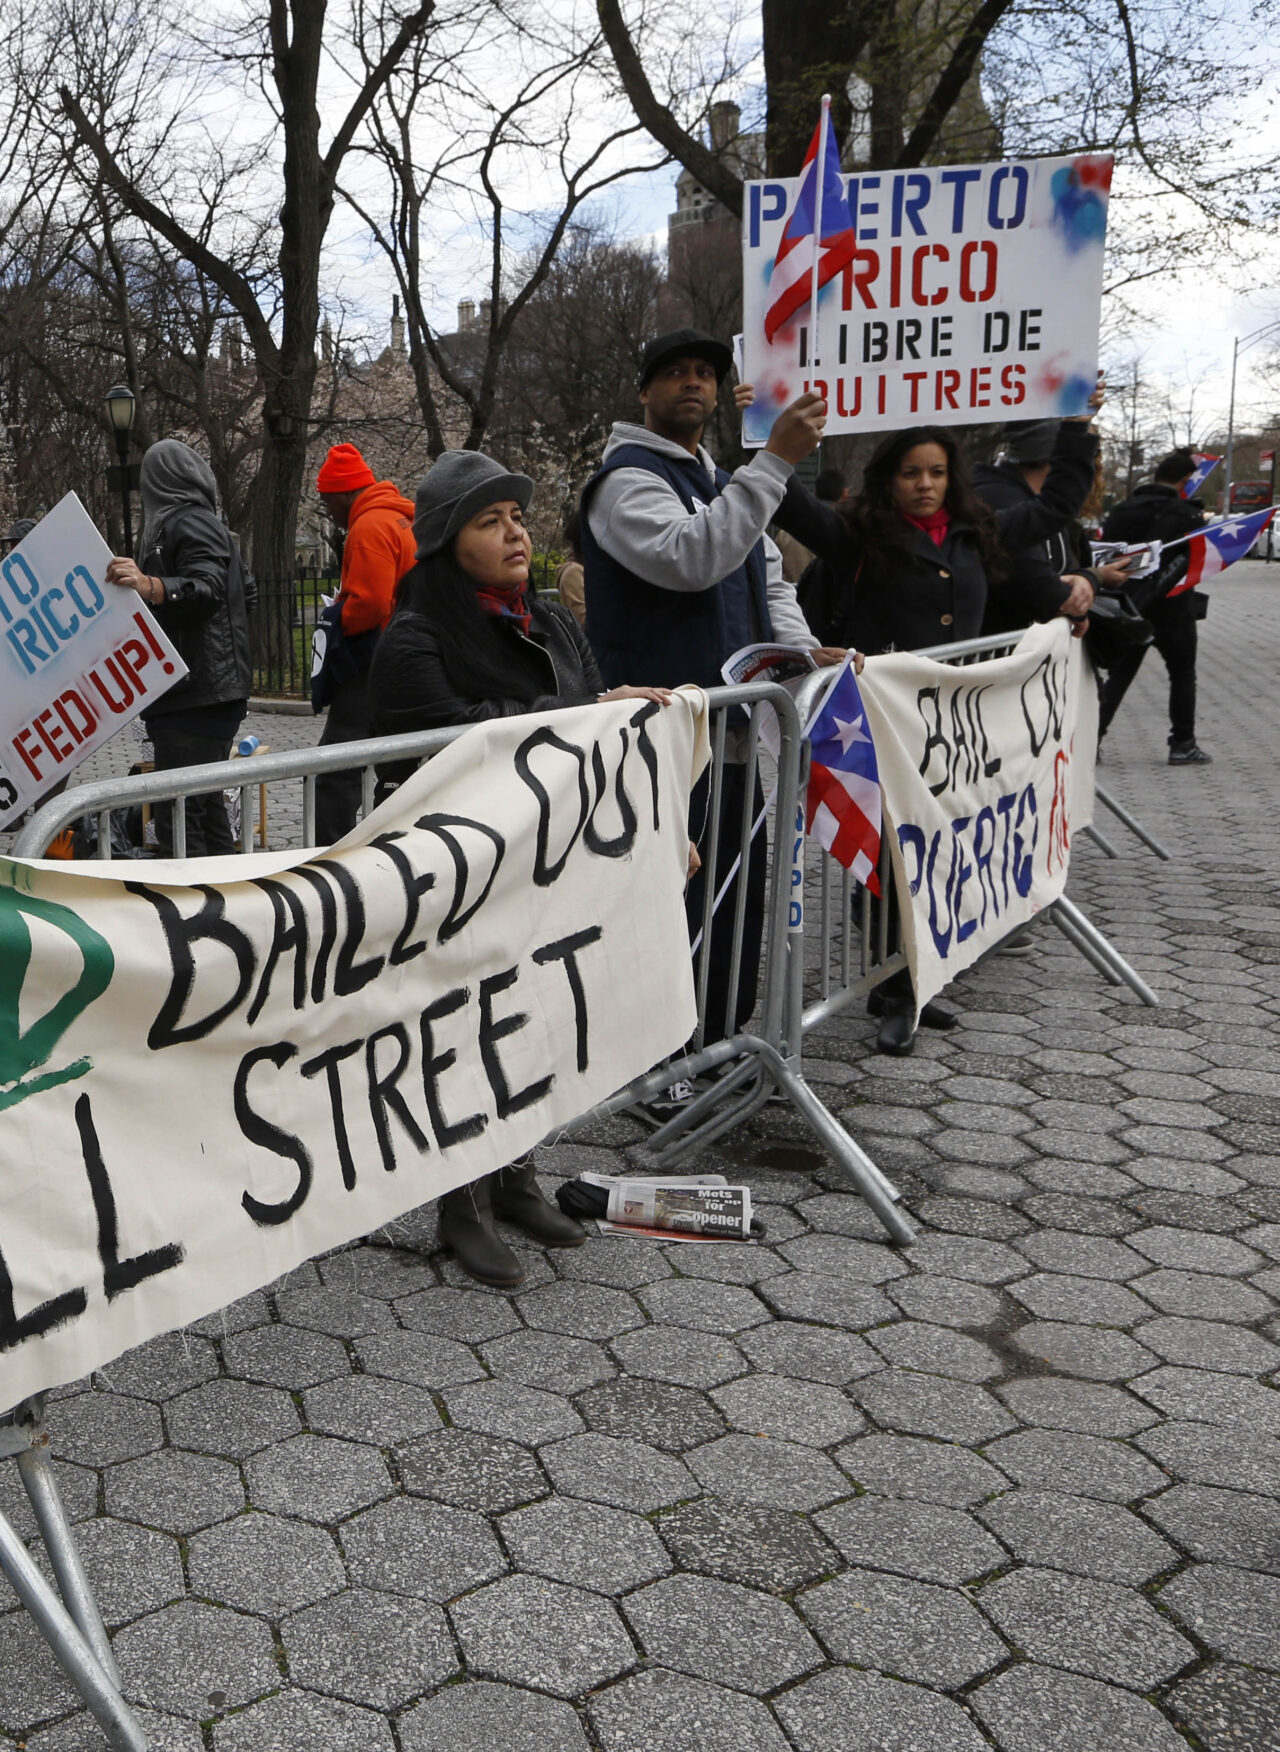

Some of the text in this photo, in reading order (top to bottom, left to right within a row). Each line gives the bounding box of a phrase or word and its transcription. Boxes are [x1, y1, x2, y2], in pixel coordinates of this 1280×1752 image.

[749, 166, 1030, 248] PERTO
[841, 240, 998, 311] RICO
[799, 309, 1043, 367] LIBRE DE
[6, 564, 105, 675] RICO
[11, 689, 98, 782] FED
[88, 611, 175, 714] UP!
[917, 684, 1002, 798] BAIL
[123, 813, 505, 1050] BAILED
[513, 703, 661, 888] OUT
[897, 783, 1039, 959] PUERTO
[232, 925, 603, 1226] STREET
[692, 1212, 742, 1227] opener
[698, 1190, 733, 1199] Mets
[705, 1199, 726, 1211] for
